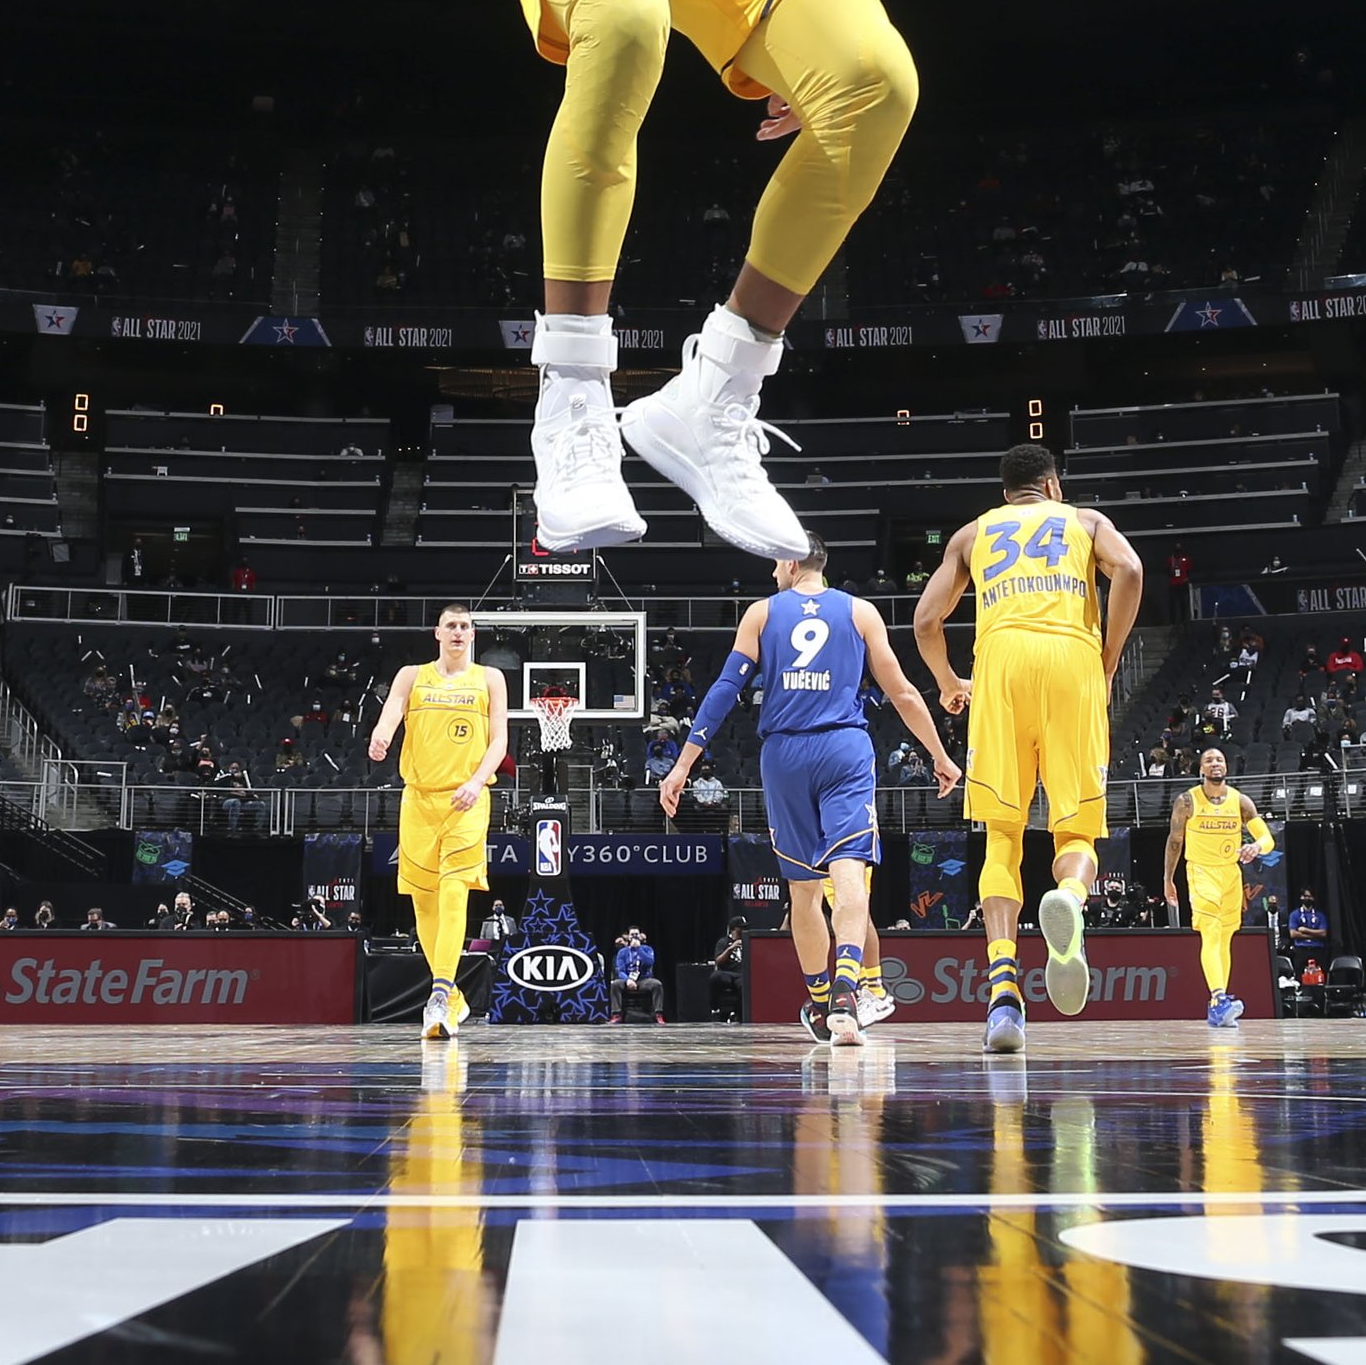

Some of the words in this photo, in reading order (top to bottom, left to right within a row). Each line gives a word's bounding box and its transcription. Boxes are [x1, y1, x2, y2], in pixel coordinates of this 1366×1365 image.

[1302, 300, 1321, 320] ALL
[1326, 297, 1355, 318] STAR
[122, 317, 142, 337] ALL
[147, 318, 176, 339] STAR
[177, 320, 201, 340] 2021
[375, 327, 394, 346] ALL
[398, 327, 428, 347] STAR
[429, 328, 452, 347] 2021
[836, 328, 855, 348] ALL
[859, 327, 888, 347] STAR
[890, 326, 913, 346] 2021
[1048, 319, 1068, 338] ALL
[1072, 317, 1101, 338] STAR
[1102, 315, 1126, 336] 2021
[983, 516, 1070, 581] 34
[539, 564, 591, 574] TISSOT
[1310, 589, 1331, 611] ALL
[790, 618, 831, 668] 9
[783, 669, 831, 691] VUČEVIĆ
[454, 725, 468, 737] 15
[532, 802, 566, 811] SPALDING
[644, 845, 707, 864] CLUB
[333, 885, 355, 901] STAR
[740, 883, 756, 900] ALL
[758, 884, 780, 901] STAR
[523, 956, 580, 981] KIA
[5, 957, 248, 1005] StateFarm
